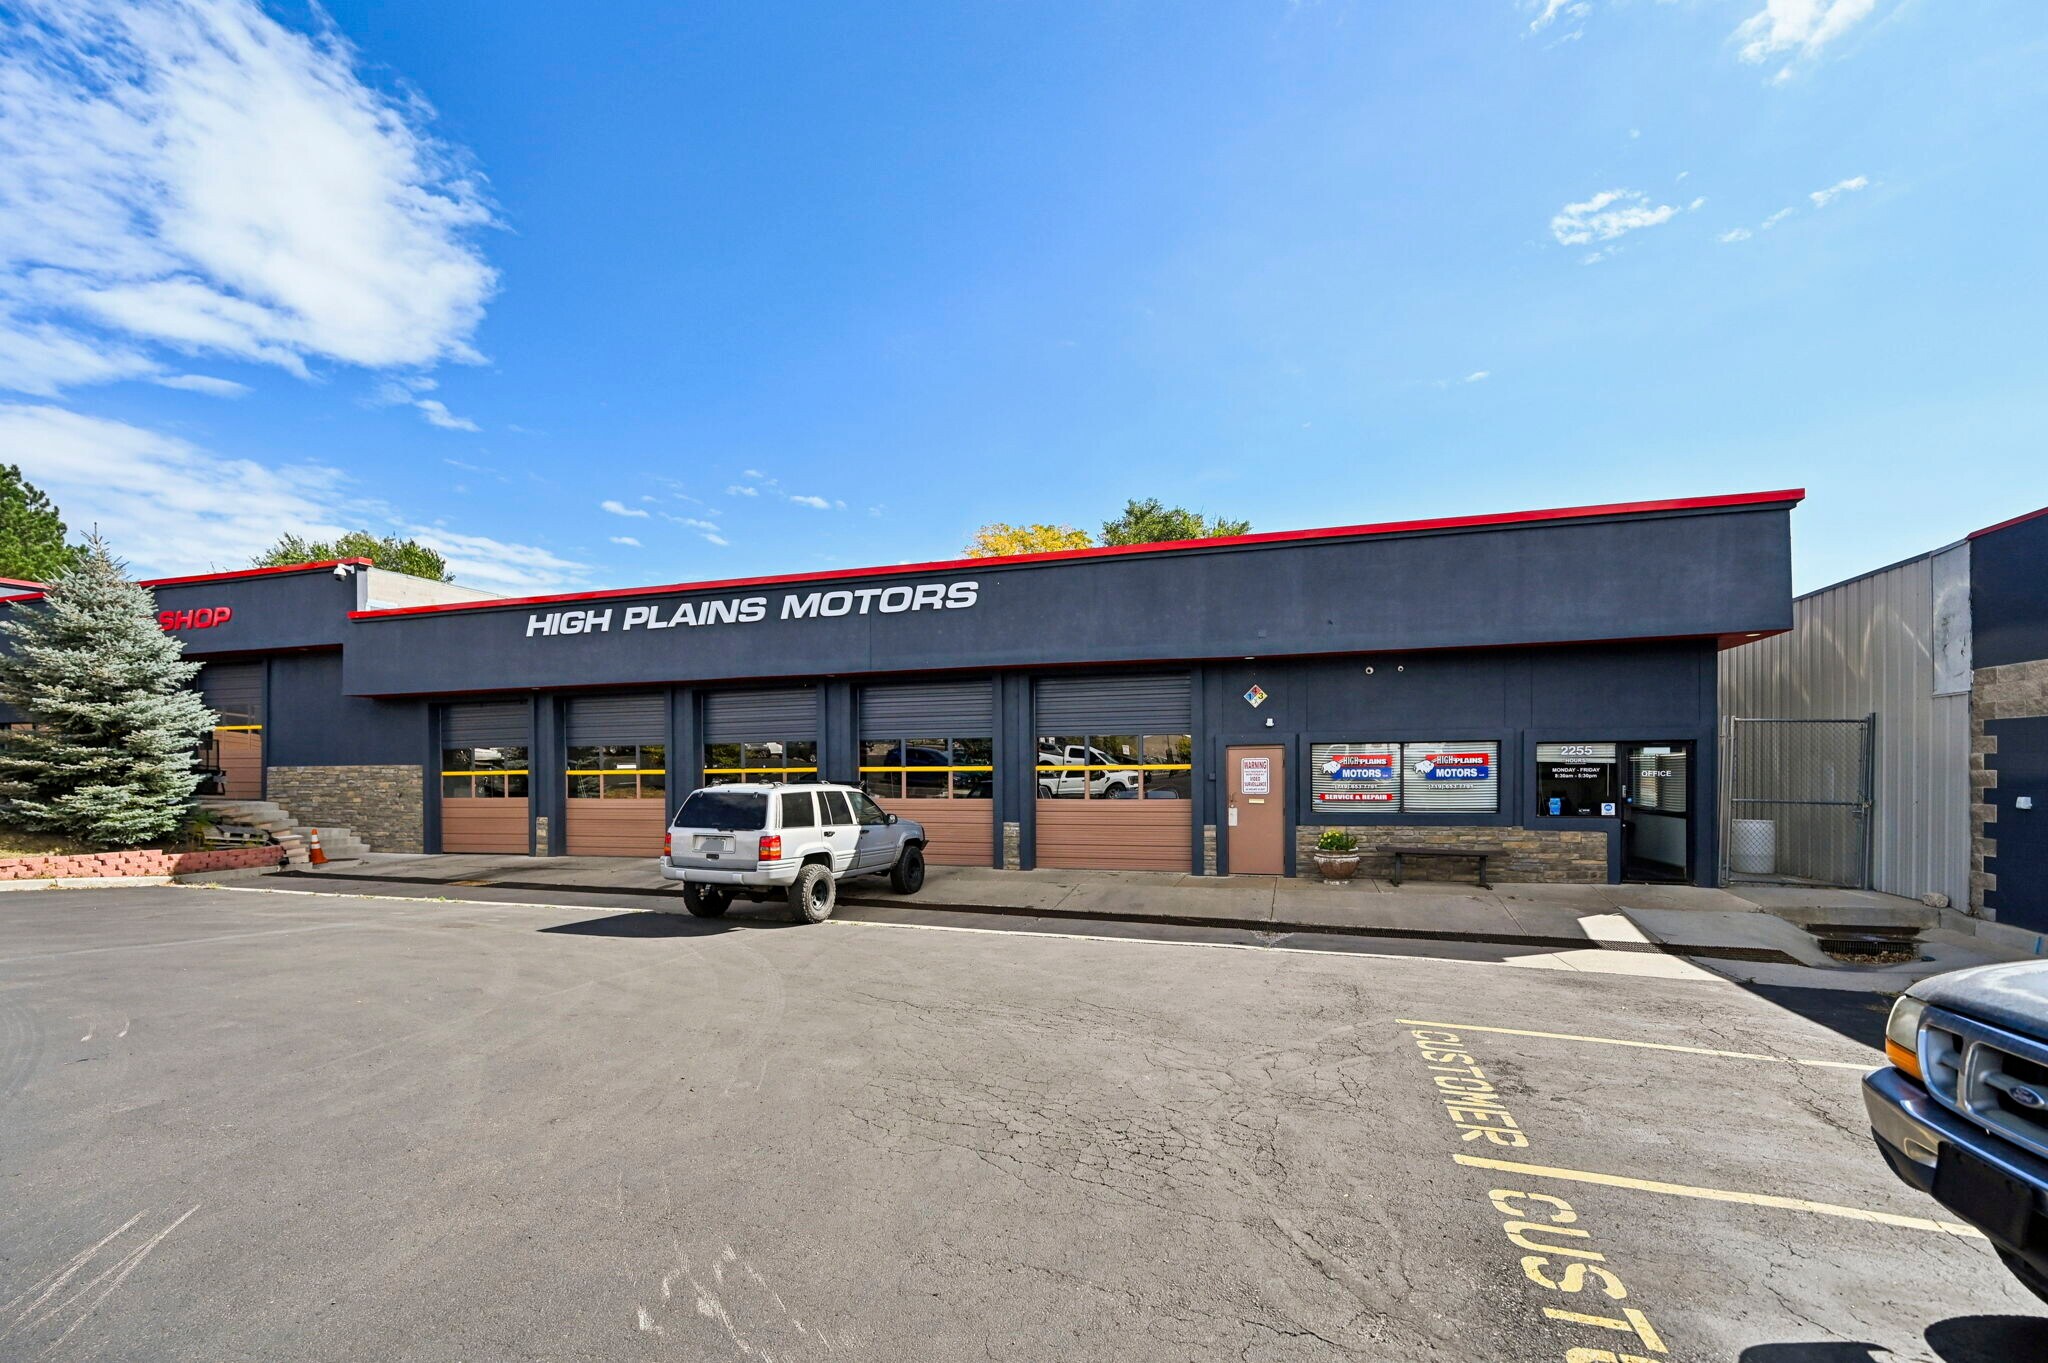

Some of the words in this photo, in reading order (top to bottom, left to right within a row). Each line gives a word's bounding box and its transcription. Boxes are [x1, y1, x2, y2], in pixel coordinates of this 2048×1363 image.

[525, 607, 613, 637] HIGH
[623, 596, 767, 631] PLAINS
[780, 581, 980, 620] MOTORS
[158, 606, 232, 630] SHOP
[1561, 745, 1593, 755] 2255
[1343, 756, 1359, 765] HIGH
[1436, 755, 1453, 764] HIGH
[1244, 761, 1267, 770] WARNING
[1342, 769, 1381, 777] MOTORS
[1436, 768, 1477, 777] MOTORS
[1411, 1028, 1529, 1148] CUSTOMER
